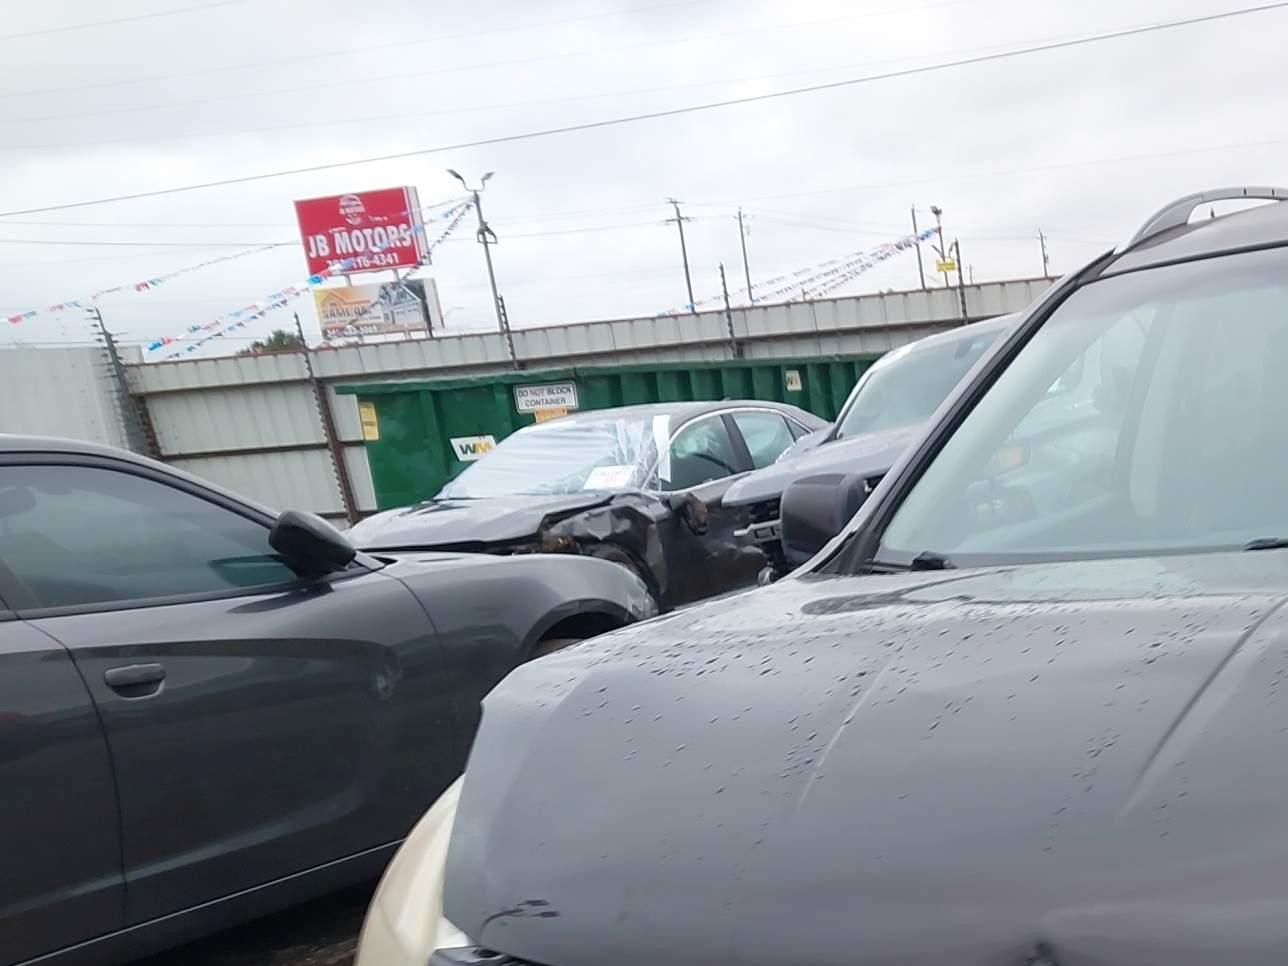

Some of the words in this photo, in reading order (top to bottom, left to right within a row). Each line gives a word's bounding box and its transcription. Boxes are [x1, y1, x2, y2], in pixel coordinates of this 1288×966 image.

[308, 234, 330, 259] JB
[333, 223, 412, 255] MOTORS
[519, 389, 529, 398] DO
[530, 388, 545, 397] NOT
[546, 386, 571, 396] BLOCK
[525, 397, 566, 408] CONTAINER
[459, 442, 492, 455] WM
